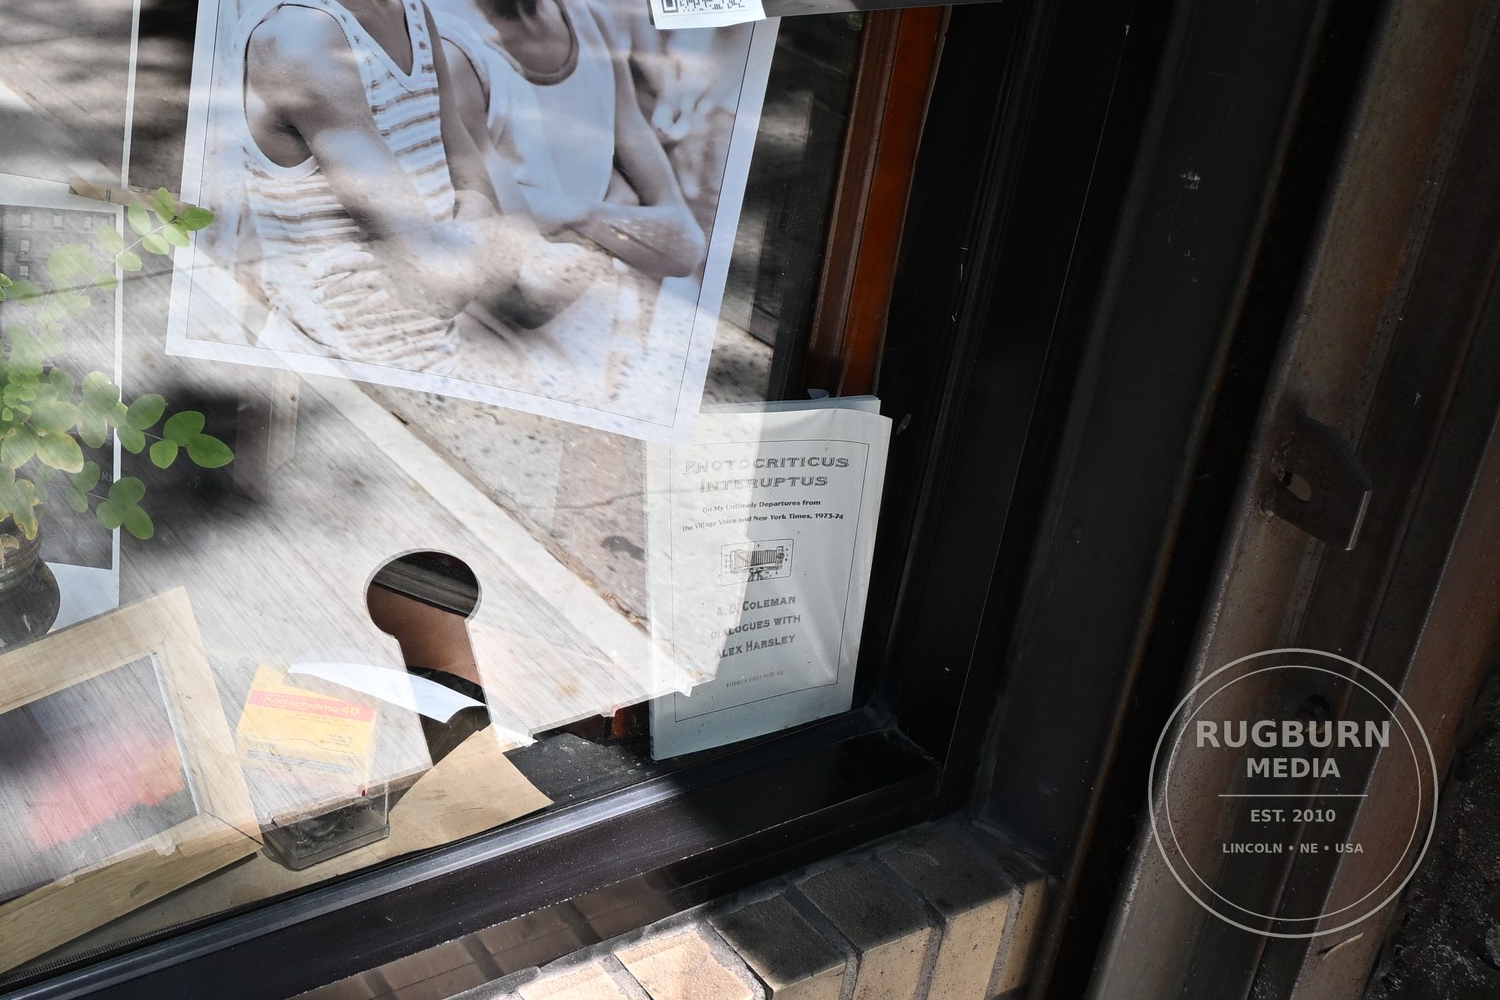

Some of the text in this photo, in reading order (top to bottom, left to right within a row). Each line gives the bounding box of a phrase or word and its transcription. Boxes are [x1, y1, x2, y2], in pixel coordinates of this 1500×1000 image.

[700, 476, 828, 493] INTERUPTUS
[702, 499, 821, 514] On My Untimely Departures from
[682, 522, 693, 531] the
[718, 516, 738, 526] Voice
[738, 514, 752, 523] and
[753, 513, 769, 521] New
[770, 513, 786, 521] York
[787, 512, 813, 521] Times,
[814, 512, 844, 521] 1973-74
[742, 596, 796, 612] COLEMAN
[710, 614, 801, 639] DIALOGUES WITH
[715, 634, 796, 658] ALEX HARSLEY
